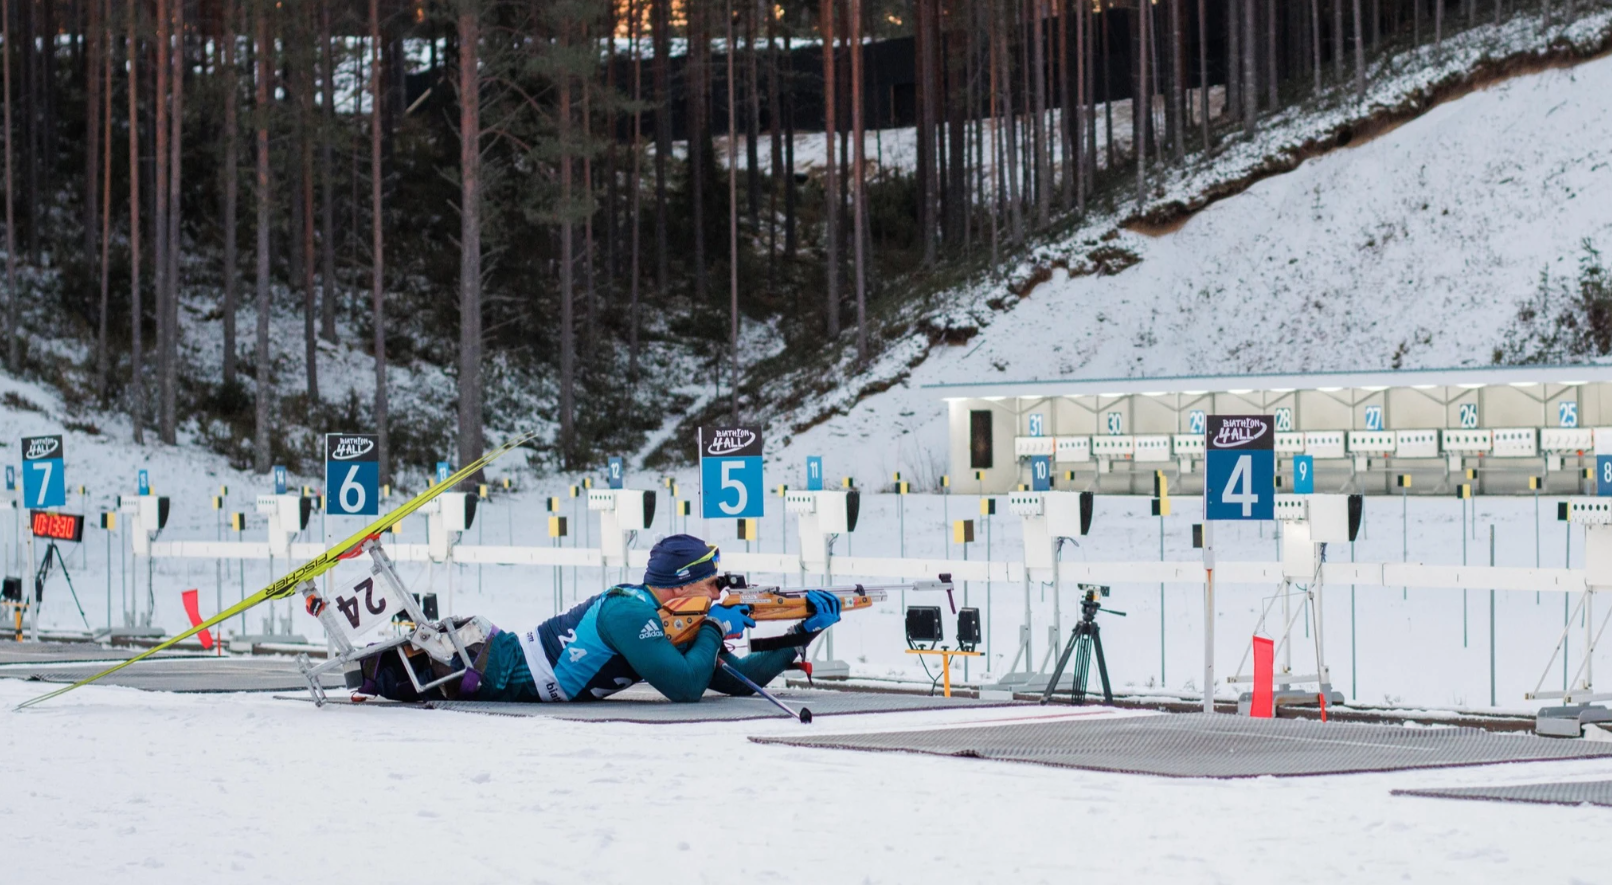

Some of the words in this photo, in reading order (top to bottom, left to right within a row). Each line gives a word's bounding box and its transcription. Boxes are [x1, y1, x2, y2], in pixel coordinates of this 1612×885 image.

[1030, 414, 1042, 436] 31
[1108, 413, 1122, 435] 30
[1190, 411, 1204, 433] 29
[1276, 408, 1291, 431] 28
[1366, 406, 1381, 430] 27
[1460, 405, 1478, 429] 26
[1559, 402, 1578, 428] 25
[712, 437, 745, 451] 4ALL
[1219, 427, 1254, 443] 4ALL
[336, 444, 364, 457] 4ALL
[610, 462, 620, 479] 12
[810, 461, 818, 479] 11
[1035, 461, 1046, 479] 10
[1299, 461, 1307, 481] 9
[1604, 461, 1612, 483] 8
[33, 462, 53, 505] 7
[339, 465, 366, 513] 6
[718, 460, 748, 515] 5
[1222, 454, 1258, 517] 4
[265, 553, 328, 596] FISCHER
[335, 577, 387, 629] 24
[558, 628, 588, 663] 24
[638, 630, 664, 640] adidas
